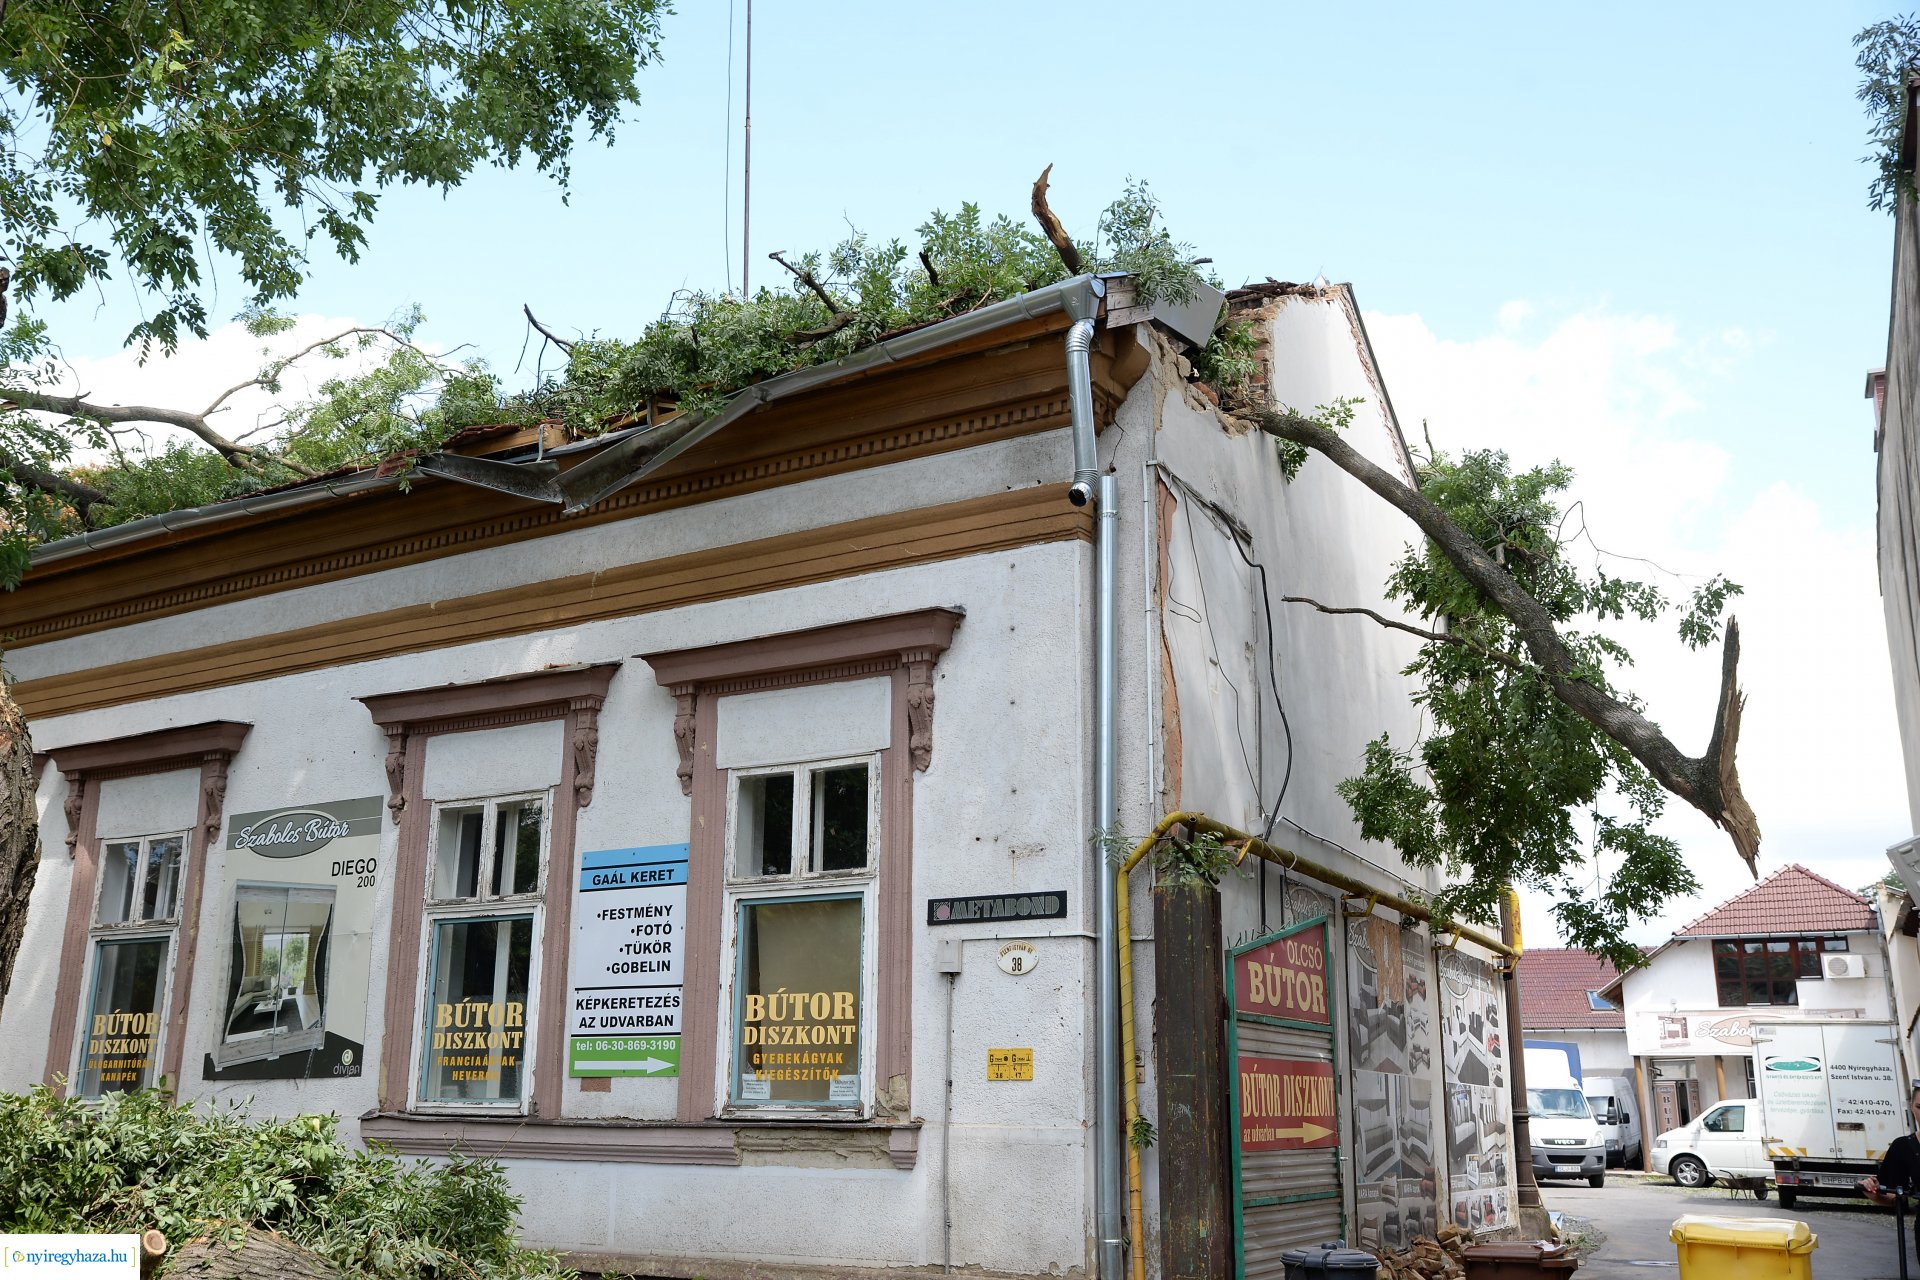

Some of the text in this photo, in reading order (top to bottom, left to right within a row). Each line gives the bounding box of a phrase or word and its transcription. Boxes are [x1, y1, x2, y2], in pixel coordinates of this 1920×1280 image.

[234, 818, 350, 849] Szabolcs Bútor
[331, 858, 377, 876] DIEGO
[357, 876, 376, 888] 200
[592, 869, 675, 885] GAÁL KERET
[950, 896, 1060, 920] METABOND
[1011, 957, 1022, 971] 38
[1286, 940, 1323, 970] OLCSÓ
[1248, 953, 1326, 1014] BÚTOR
[576, 993, 680, 1011] KÉPKERETEZÉS
[744, 987, 855, 1022] BÚTOR
[436, 997, 523, 1028] BÚTOR
[579, 1014, 674, 1029] AZ UDVARBAN
[92, 1008, 160, 1036] BÚTOR
[433, 1031, 523, 1050] DISZKONT
[743, 1025, 856, 1045] DISZKONT
[89, 1038, 158, 1055] DISZKONT
[576, 1039, 676, 1051] tel: 06-30-869-3190
[753, 1051, 844, 1065] GYEREKÁGYAK
[101, 1070, 137, 1081] KANAPÉK
[333, 1063, 360, 1075] divian
[755, 1067, 840, 1081] KIEGÉSZÍTŐK
[1242, 1063, 1335, 1118] BÚTOR DISZKONT
[1243, 1128, 1251, 1143] az
